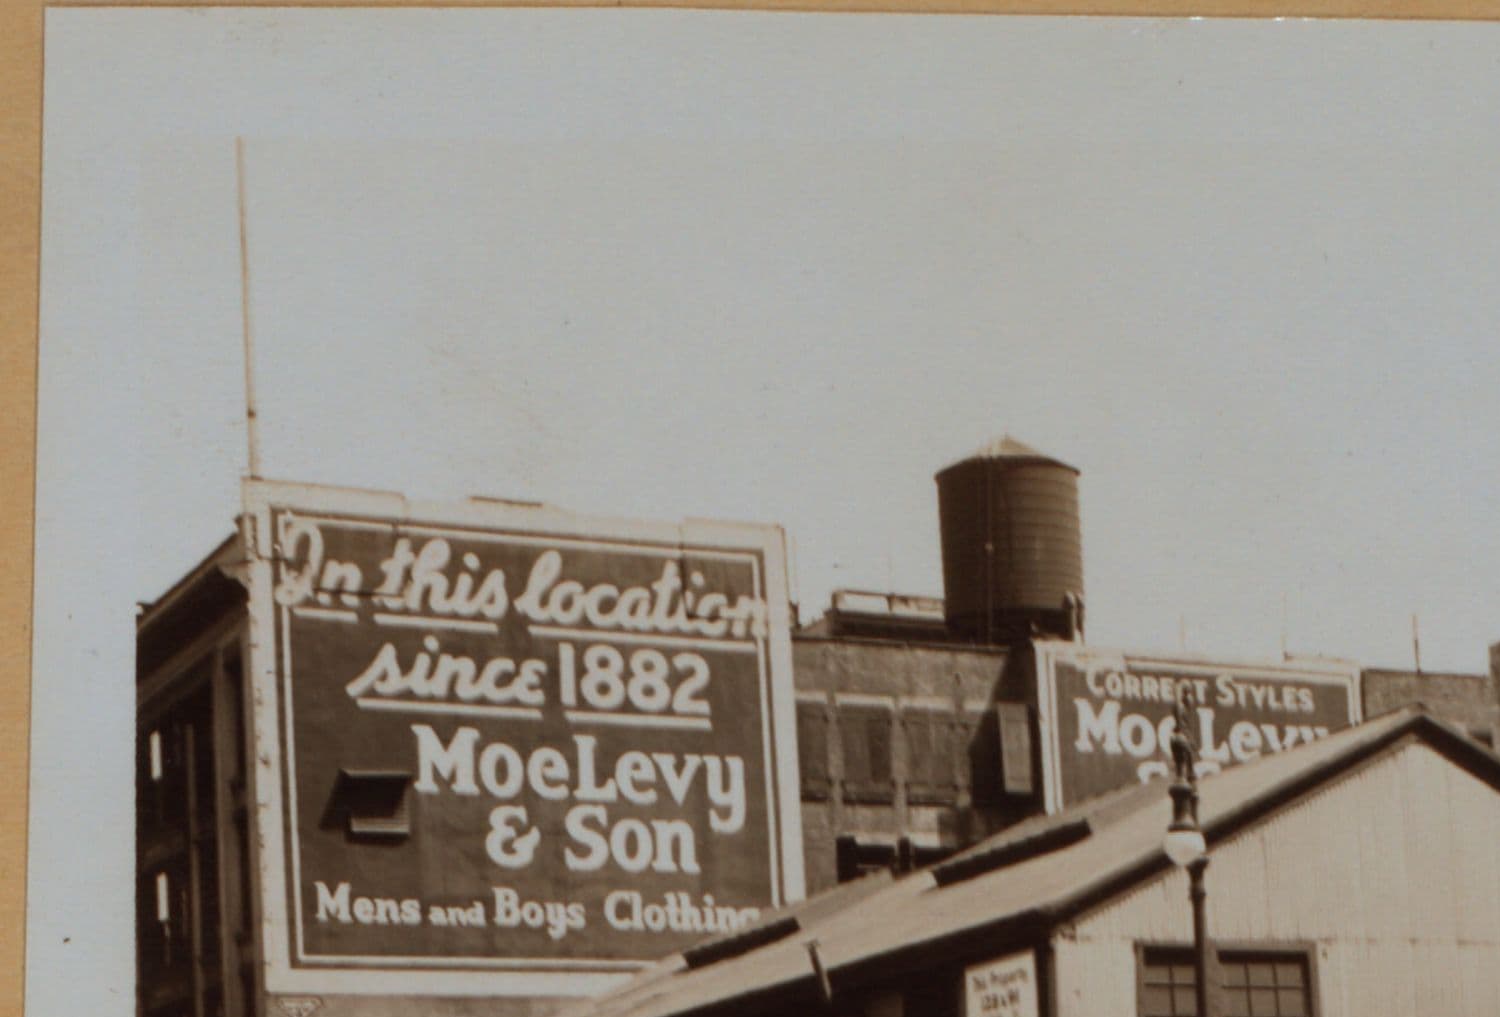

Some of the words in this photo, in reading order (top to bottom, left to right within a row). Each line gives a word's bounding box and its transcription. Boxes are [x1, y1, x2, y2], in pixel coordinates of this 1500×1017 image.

[275, 510, 362, 607] In
[374, 537, 507, 621] this
[513, 549, 768, 636] location
[346, 637, 547, 704] since
[558, 642, 711, 714] 1882
[485, 805, 540, 868] &
[564, 804, 701, 873] Son
[315, 882, 421, 925] Mens
[428, 900, 486, 926] and
[493, 887, 585, 939] Boys
